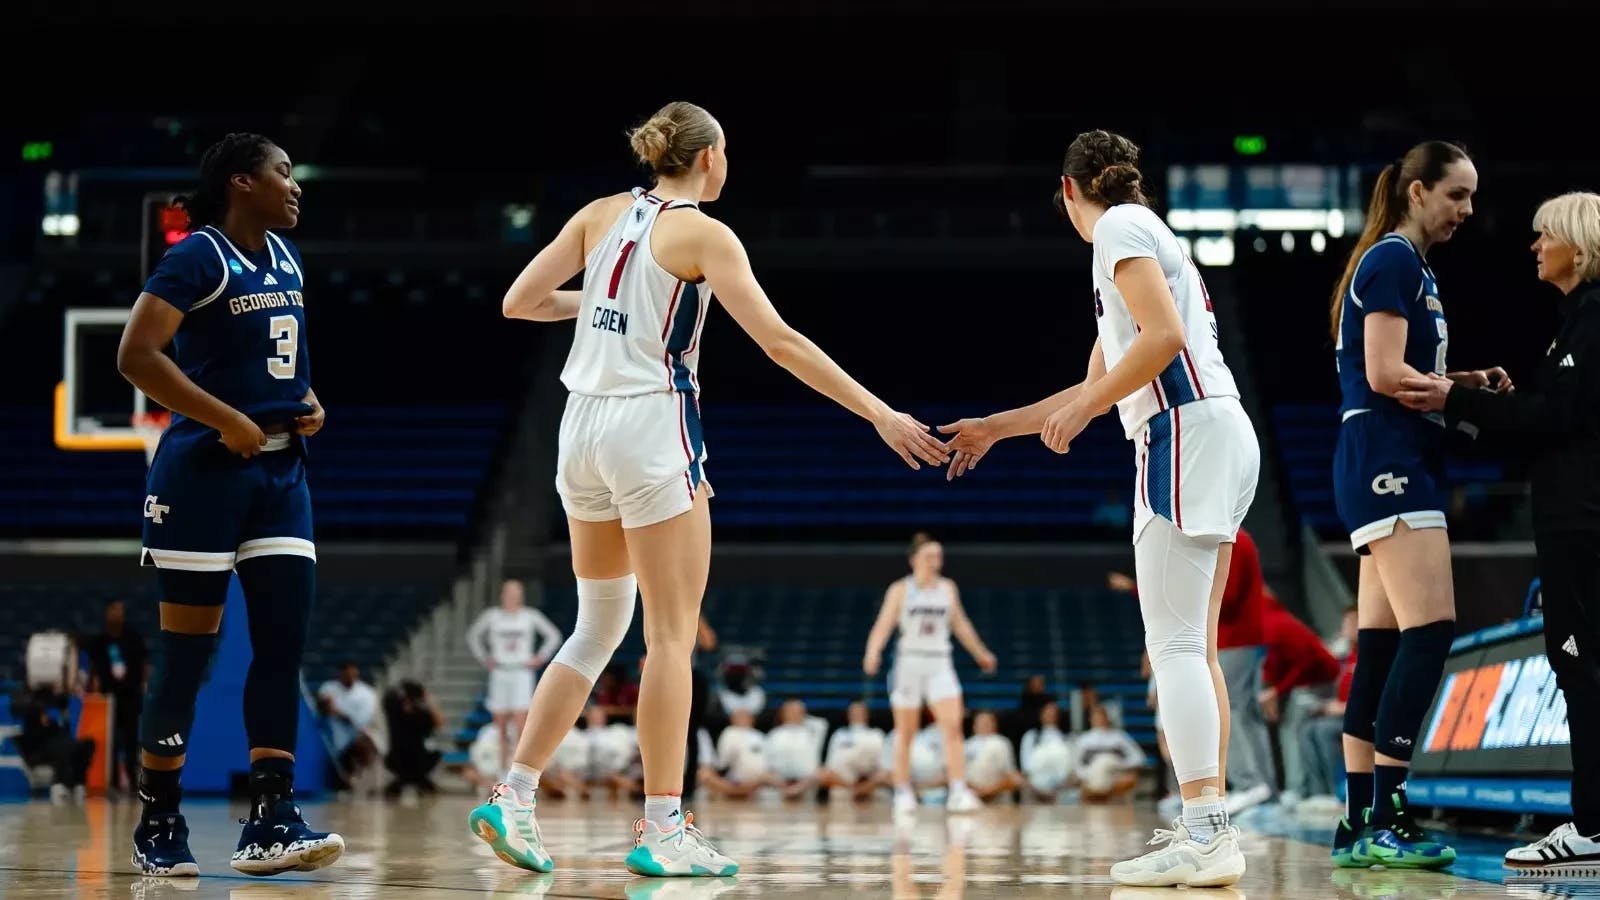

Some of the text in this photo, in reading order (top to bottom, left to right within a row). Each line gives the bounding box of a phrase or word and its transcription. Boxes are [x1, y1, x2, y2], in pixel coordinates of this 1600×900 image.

[229, 292, 289, 315] GEORGIA
[267, 314, 299, 380] 3
[1372, 471, 1409, 496] GT
[144, 494, 170, 524] GT
